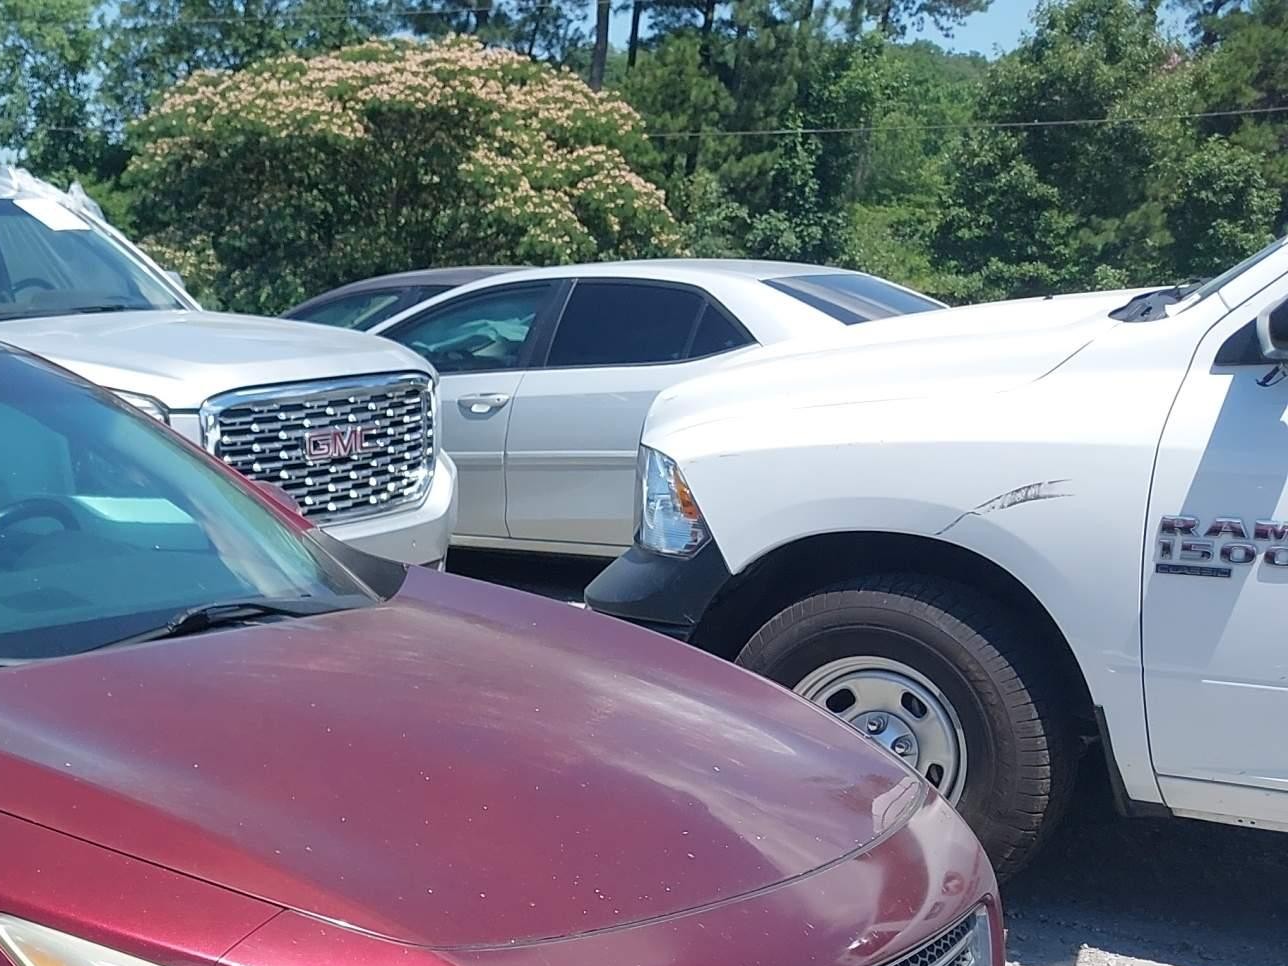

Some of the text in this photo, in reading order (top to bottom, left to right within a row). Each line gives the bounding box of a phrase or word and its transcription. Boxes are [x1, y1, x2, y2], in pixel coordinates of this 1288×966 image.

[305, 426, 378, 460] GMC
[1158, 515, 1288, 540] RAM
[1157, 540, 1288, 565] 1500
